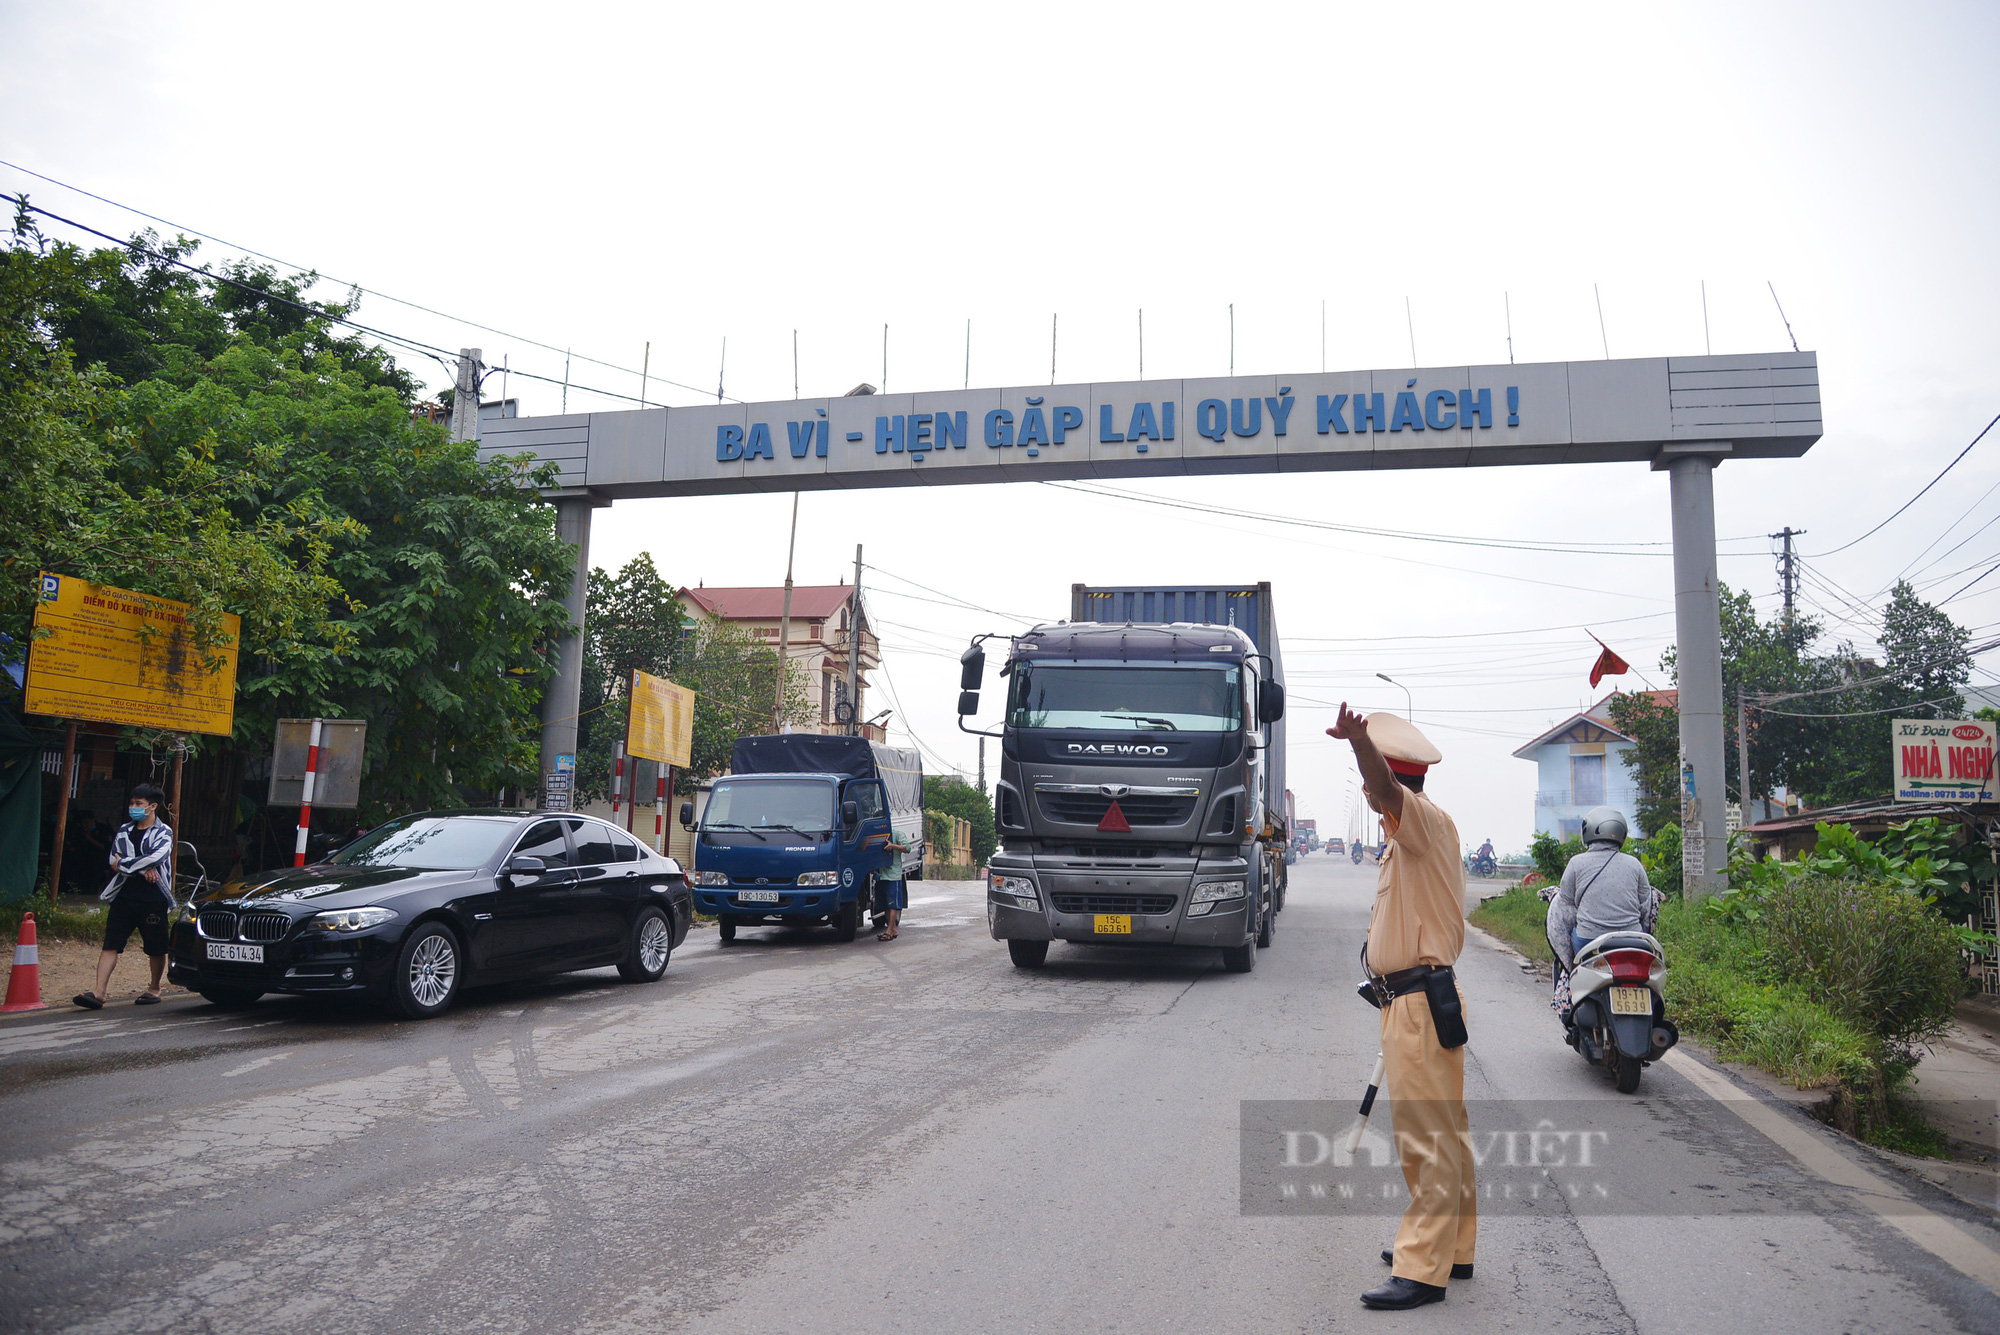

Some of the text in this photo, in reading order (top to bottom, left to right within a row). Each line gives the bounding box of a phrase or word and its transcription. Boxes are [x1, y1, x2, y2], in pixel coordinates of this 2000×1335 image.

[716, 421, 774, 462] BA
[787, 408, 829, 458] VÌ
[875, 410, 967, 462] HẸN
[984, 396, 1083, 458] GẶP
[1100, 401, 1175, 453] LẠI
[1197, 386, 1295, 443] QUÝ
[1316, 378, 1492, 435] KHÁCH
[112, 591, 128, 601] GIAO
[83, 594, 105, 608] ĐIỂM
[121, 603, 132, 614] XE
[1899, 724, 1919, 736] Xứ
[1955, 727, 1981, 737] 24/24
[1067, 743, 1169, 756] DAEWOO
[1901, 735, 1994, 779] NHÀ NGHỈ
[1105, 915, 1121, 924] 15C
[1097, 924, 1127, 933] 063.61
[1616, 988, 1645, 1001] 19-T1
[1617, 1001, 1646, 1013] 5639
